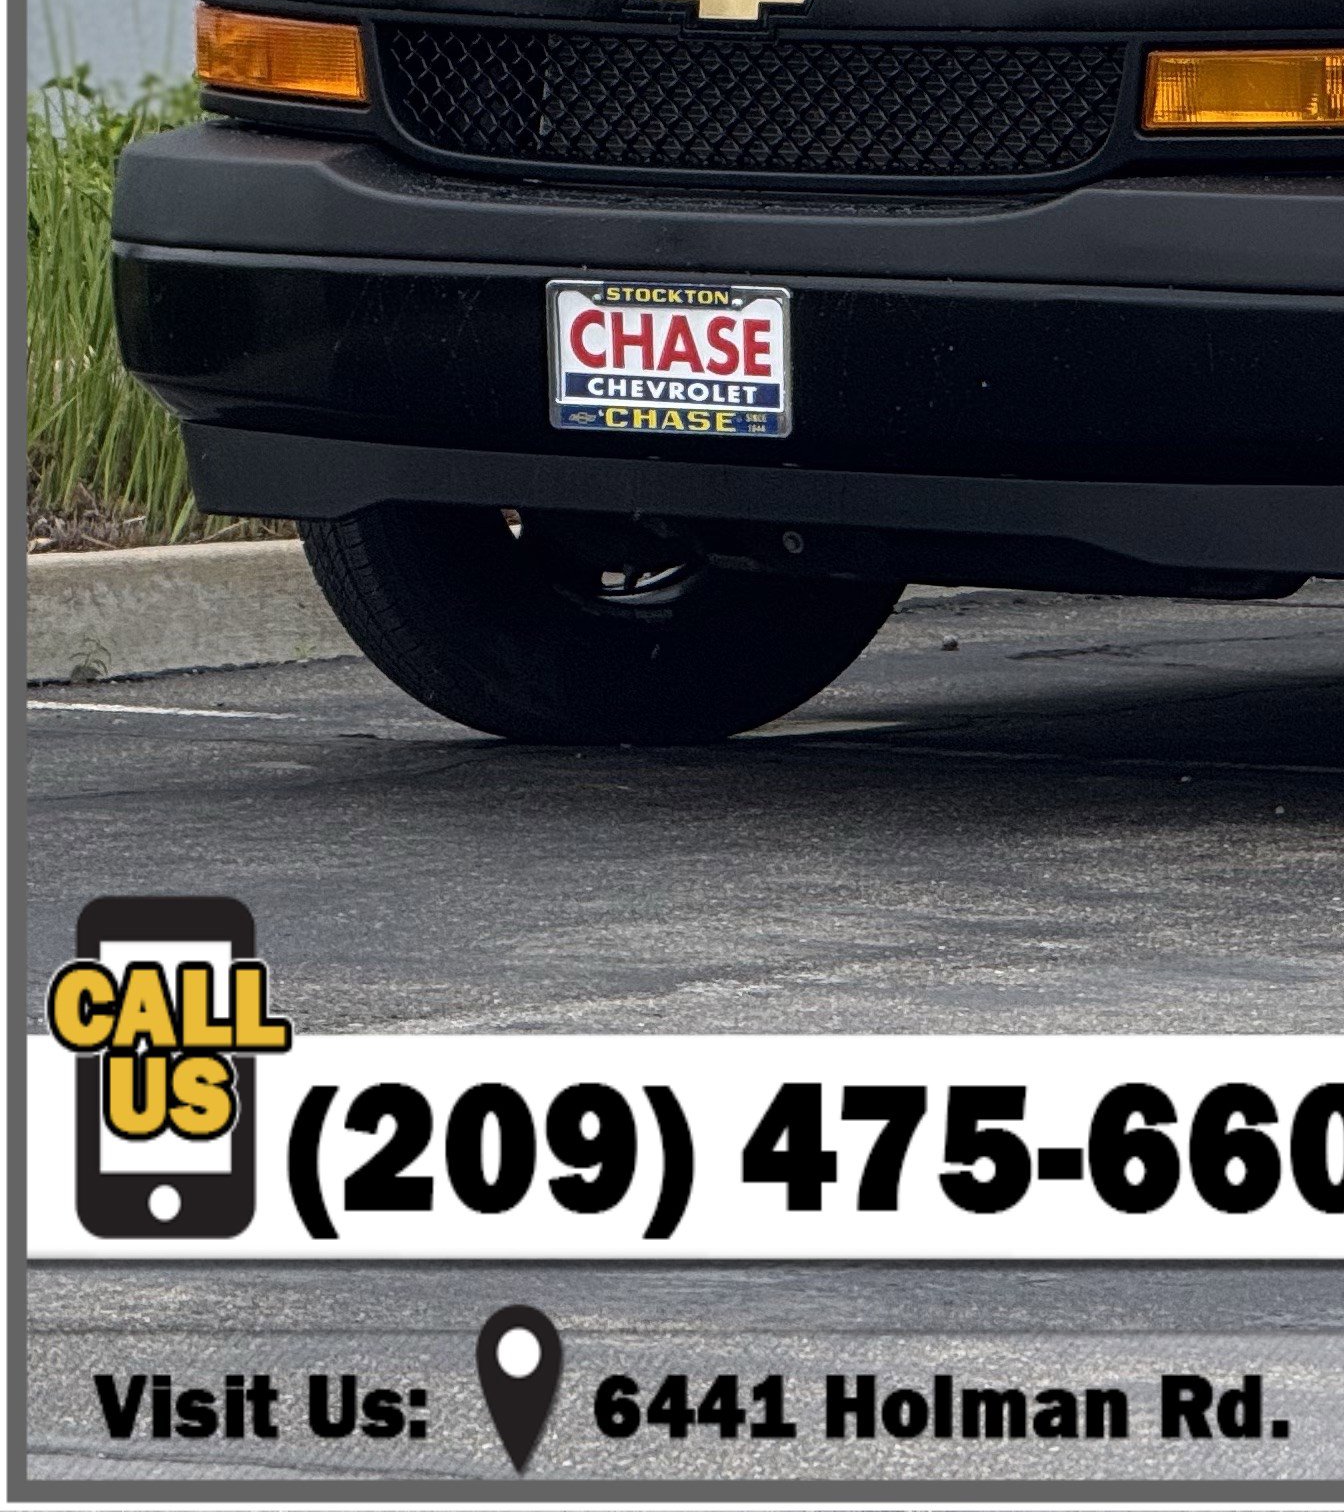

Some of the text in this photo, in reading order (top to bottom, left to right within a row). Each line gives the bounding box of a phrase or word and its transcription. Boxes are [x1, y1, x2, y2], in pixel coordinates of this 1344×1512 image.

[606, 287, 730, 306] STOCKTON
[569, 308, 772, 377] CHASE
[587, 377, 758, 405] CHEVROLET
